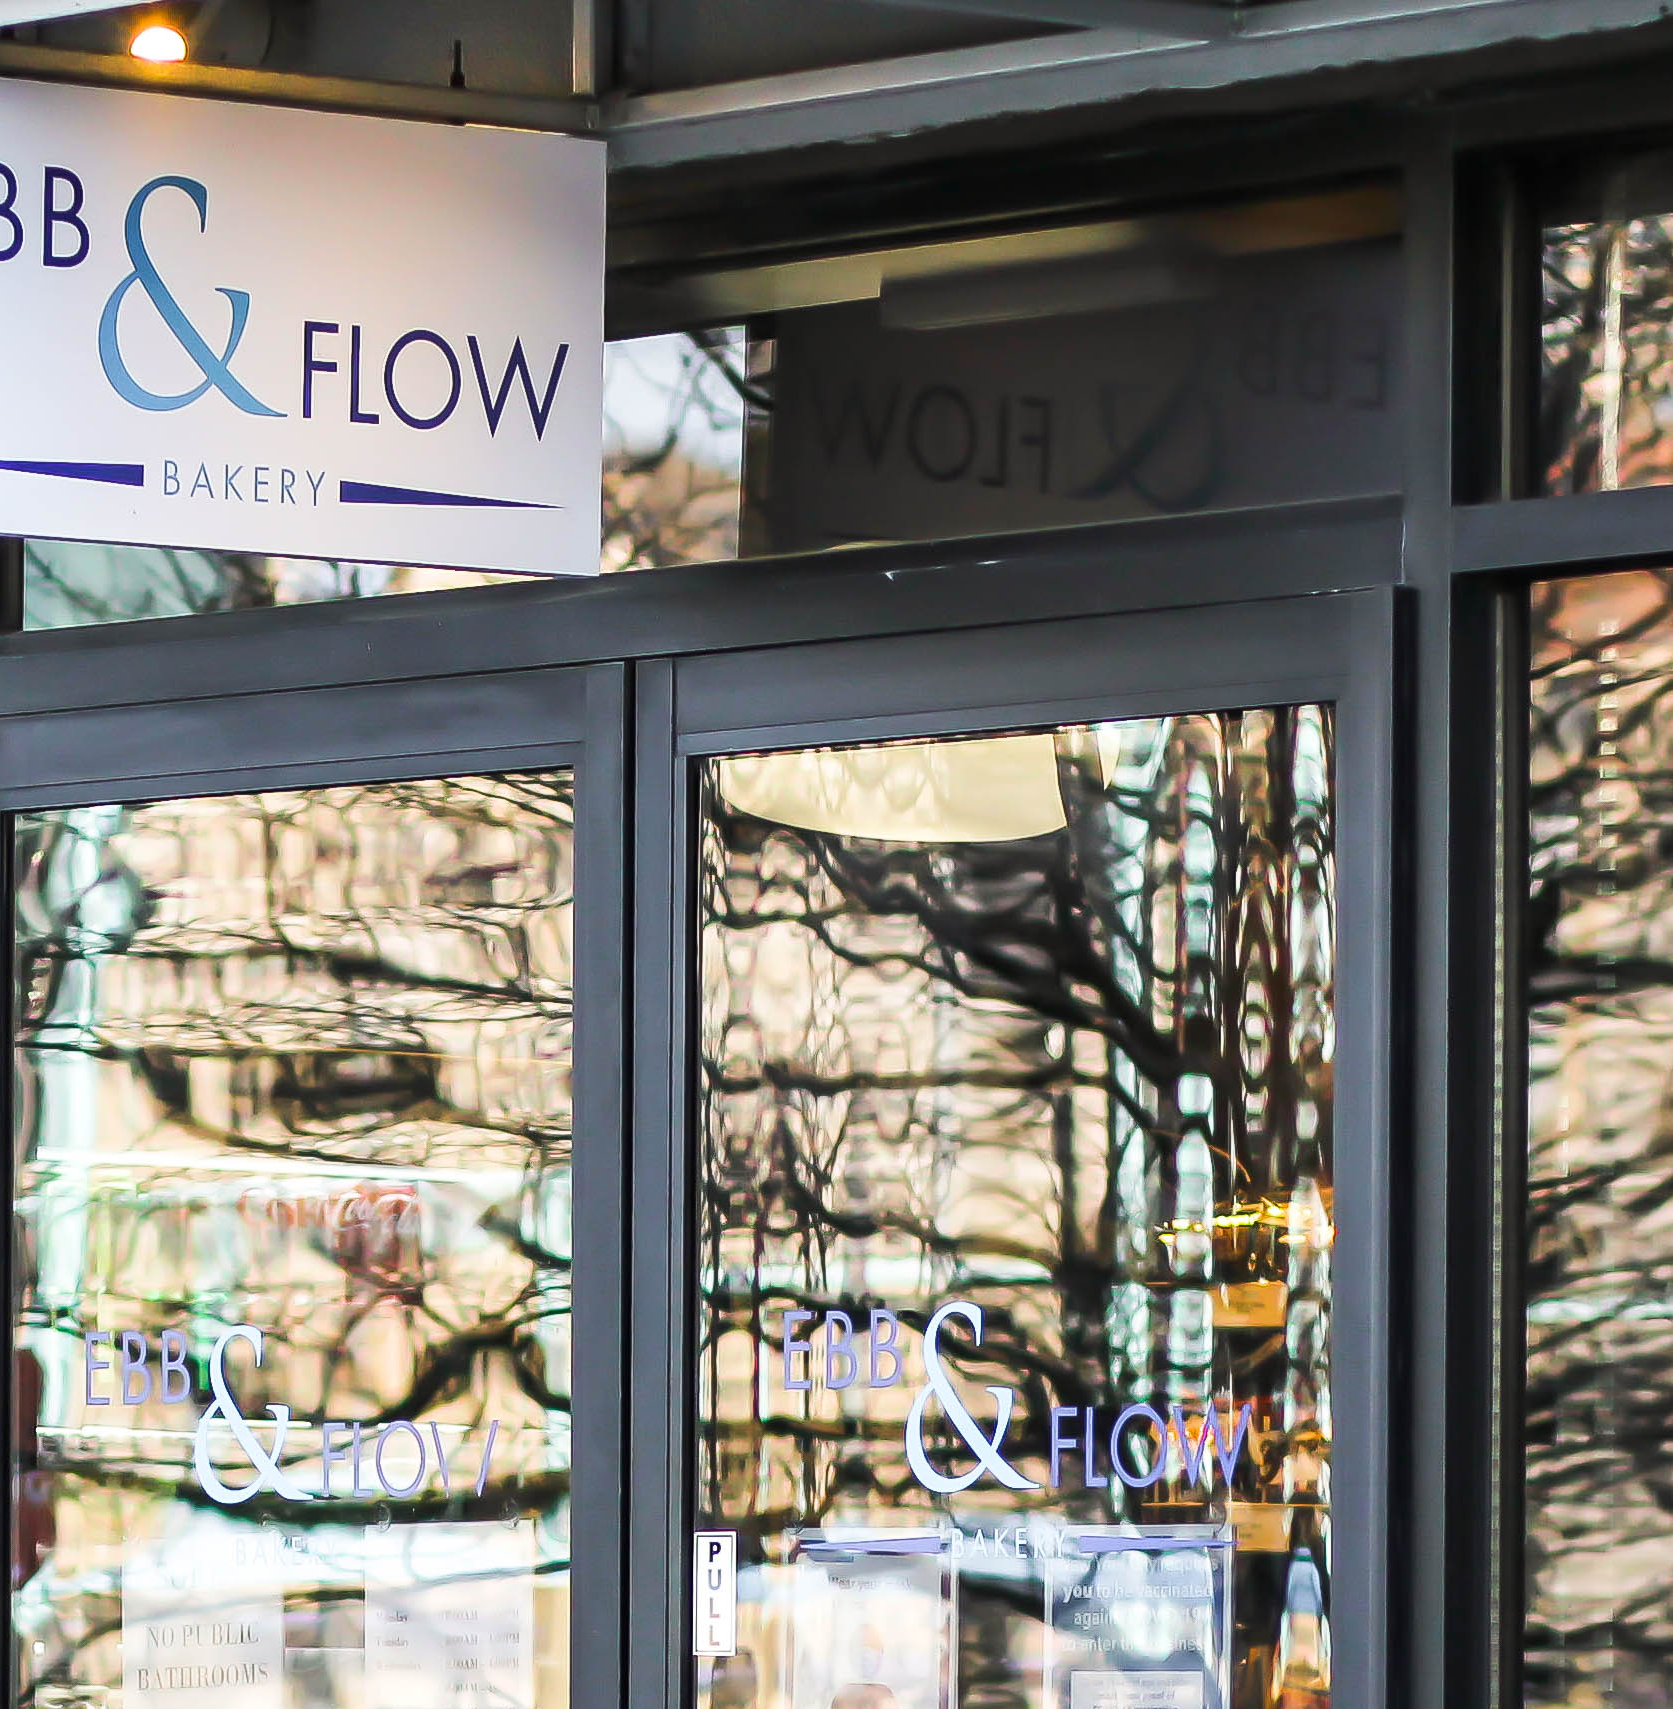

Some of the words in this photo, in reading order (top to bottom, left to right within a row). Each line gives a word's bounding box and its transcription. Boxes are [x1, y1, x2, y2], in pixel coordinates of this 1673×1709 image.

[98, 175, 288, 417] &
[302, 321, 569, 442] FLOW
[163, 460, 325, 507] BAKERY
[84, 1329, 192, 1406] EBB
[782, 1309, 903, 1391] EBB
[194, 1323, 313, 1504] &
[905, 1301, 1043, 1494] &
[1050, 1403, 1252, 1489] FLOW
[950, 1527, 1065, 1558] BAKERY
[147, 1625, 174, 1648] NO
[183, 1622, 260, 1647] PUBLIC
[708, 1541, 722, 1647] PULL
[137, 1662, 269, 1690] BATHROOMS
